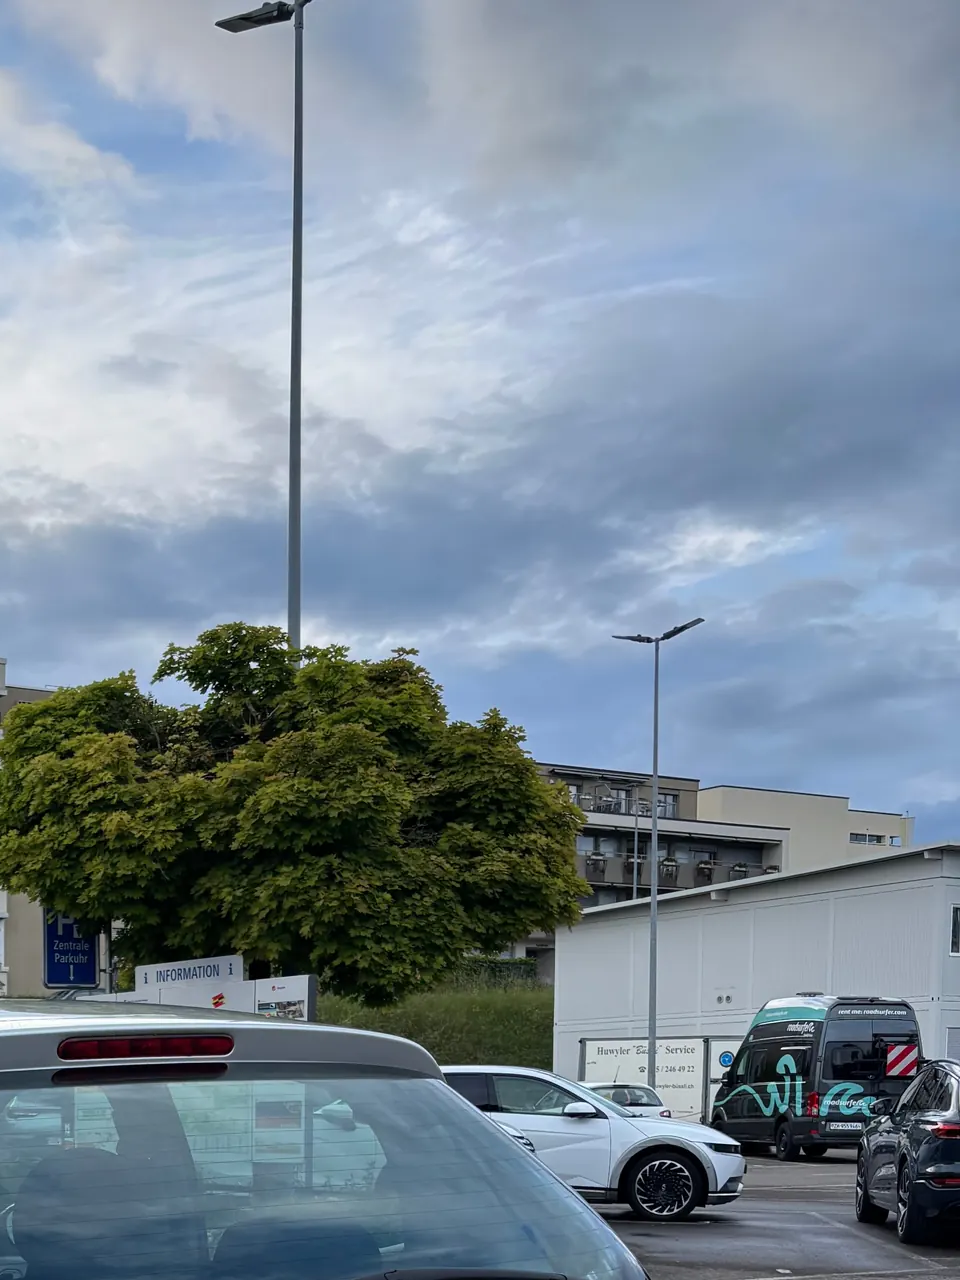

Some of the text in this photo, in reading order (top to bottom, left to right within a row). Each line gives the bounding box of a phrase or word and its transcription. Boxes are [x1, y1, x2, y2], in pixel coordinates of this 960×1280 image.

[53, 940, 90, 951] Zentrale
[54, 953, 88, 963] Parkuhr
[156, 964, 220, 983] INFORMATION
[863, 1008, 907, 1016] roadsurfer.com
[597, 1046, 631, 1057] Huwyler
[665, 1045, 695, 1055] Service
[665, 1065, 677, 1073] 246
[677, 1065, 686, 1073] 49
[687, 1065, 695, 1073] 22
